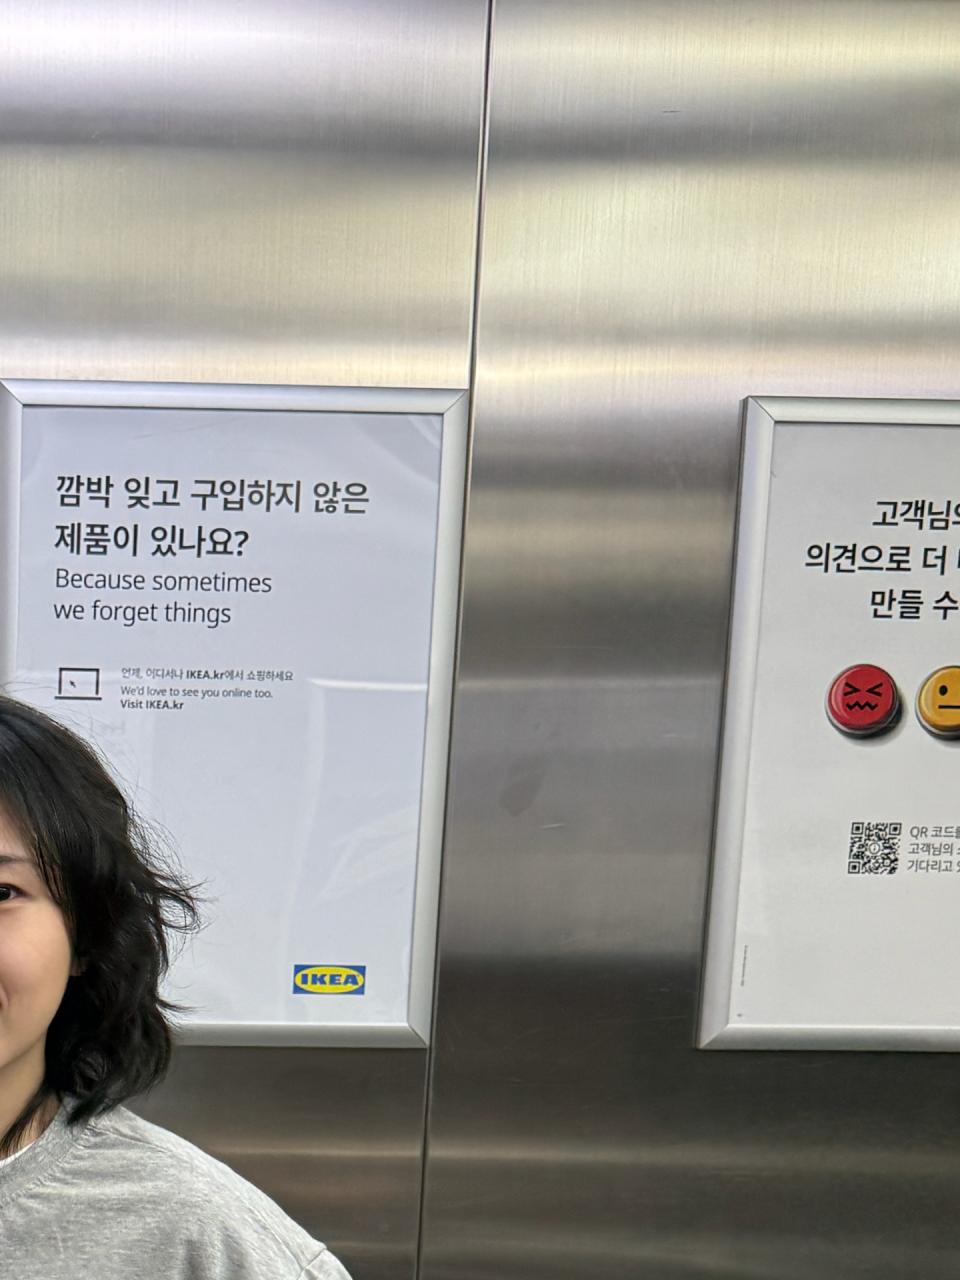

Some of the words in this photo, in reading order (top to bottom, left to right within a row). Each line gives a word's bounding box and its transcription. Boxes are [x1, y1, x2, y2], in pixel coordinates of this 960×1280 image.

[56, 474, 115, 509] 깜박
[124, 476, 181, 510] 잊고
[191, 478, 302, 513] 구입하지
[313, 480, 370, 516] 않은
[54, 522, 139, 557] 제품이
[150, 524, 250, 559] 있나요?
[805, 542, 912, 574] 의견으로
[922, 545, 947, 576] 더
[55, 568, 146, 590] Because
[152, 571, 273, 593] sometimes
[871, 588, 924, 620] 만들
[932, 590, 959, 621] 수
[53, 603, 85, 620] we
[91, 599, 159, 627] forget
[165, 601, 232, 629] things
[121, 667, 143, 680] 언제,
[145, 667, 184, 681] 어디서나
[186, 669, 244, 682] IKEA.kr에서
[246, 670, 294, 682] 쇼핑하세요
[120, 685, 145, 697] We'd
[146, 686, 167, 697] love
[169, 687, 180, 697] to
[181, 688, 200, 697] see
[200, 688, 220, 700] you
[221, 687, 252, 698] online
[254, 689, 274, 699] too.
[120, 699, 144, 709] Visit
[145, 700, 185, 710] IKEA.kr
[910, 826, 929, 840] QR
[907, 842, 954, 857] 고객님의
[907, 859, 953, 873] 기다리고
[300, 973, 360, 986] IKEA
